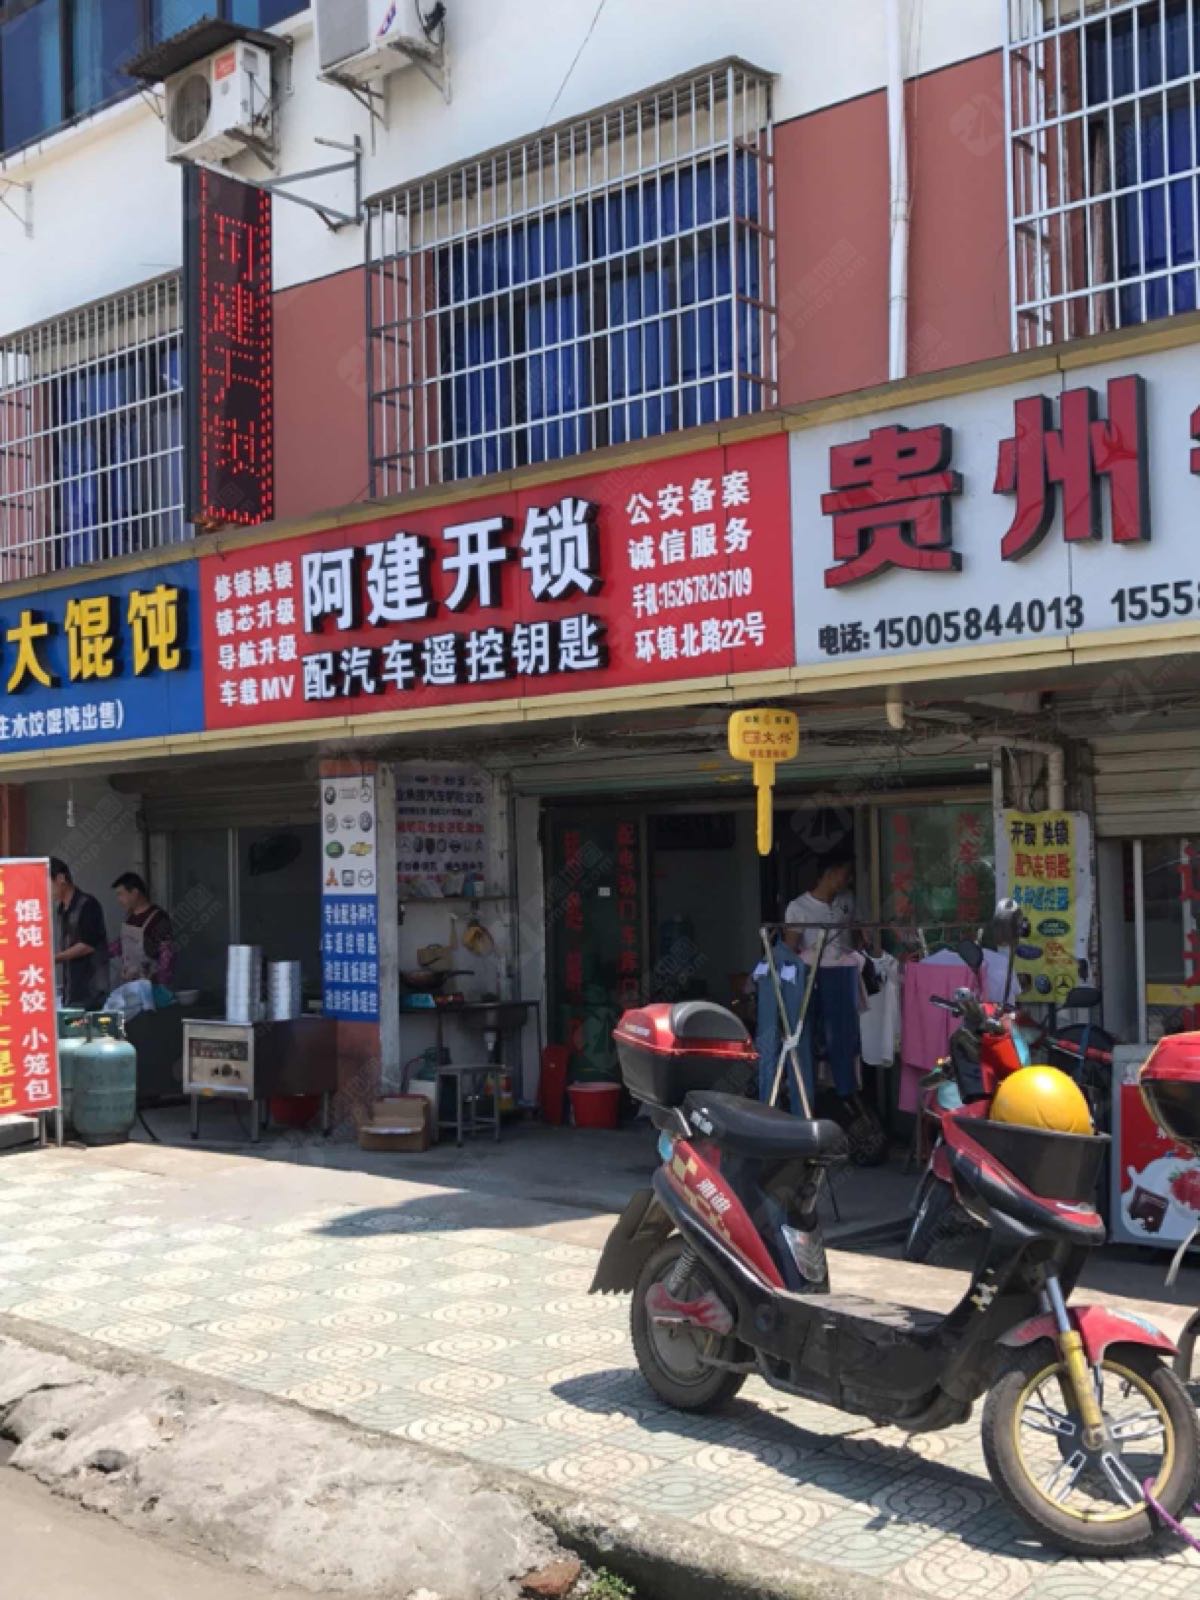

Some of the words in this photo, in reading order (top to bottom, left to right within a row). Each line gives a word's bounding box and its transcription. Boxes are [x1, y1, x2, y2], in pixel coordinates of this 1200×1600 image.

[626, 470, 751, 526] 公安备案
[821, 374, 1200, 588] 贵州
[301, 497, 597, 633] 阿建开锁
[627, 517, 752, 571] 诚信服务
[214, 561, 293, 602] 修锁换锁
[6, 584, 181, 694] 大馄饨
[215, 597, 295, 637] 锁芯升级
[634, 611, 766, 663] 环镇北路22号
[819, 594, 1084, 655] 电话:15005844013
[1111, 580, 1200, 622] 1555
[217, 634, 298, 671] 导航升级
[302, 614, 600, 700] 配汽车遥控钥匙
[219, 675, 295, 708] 车载MV
[14, 898, 44, 948] 馄饨
[19, 964, 47, 1014] 水饺
[22, 1027, 51, 1101] 小笼包
